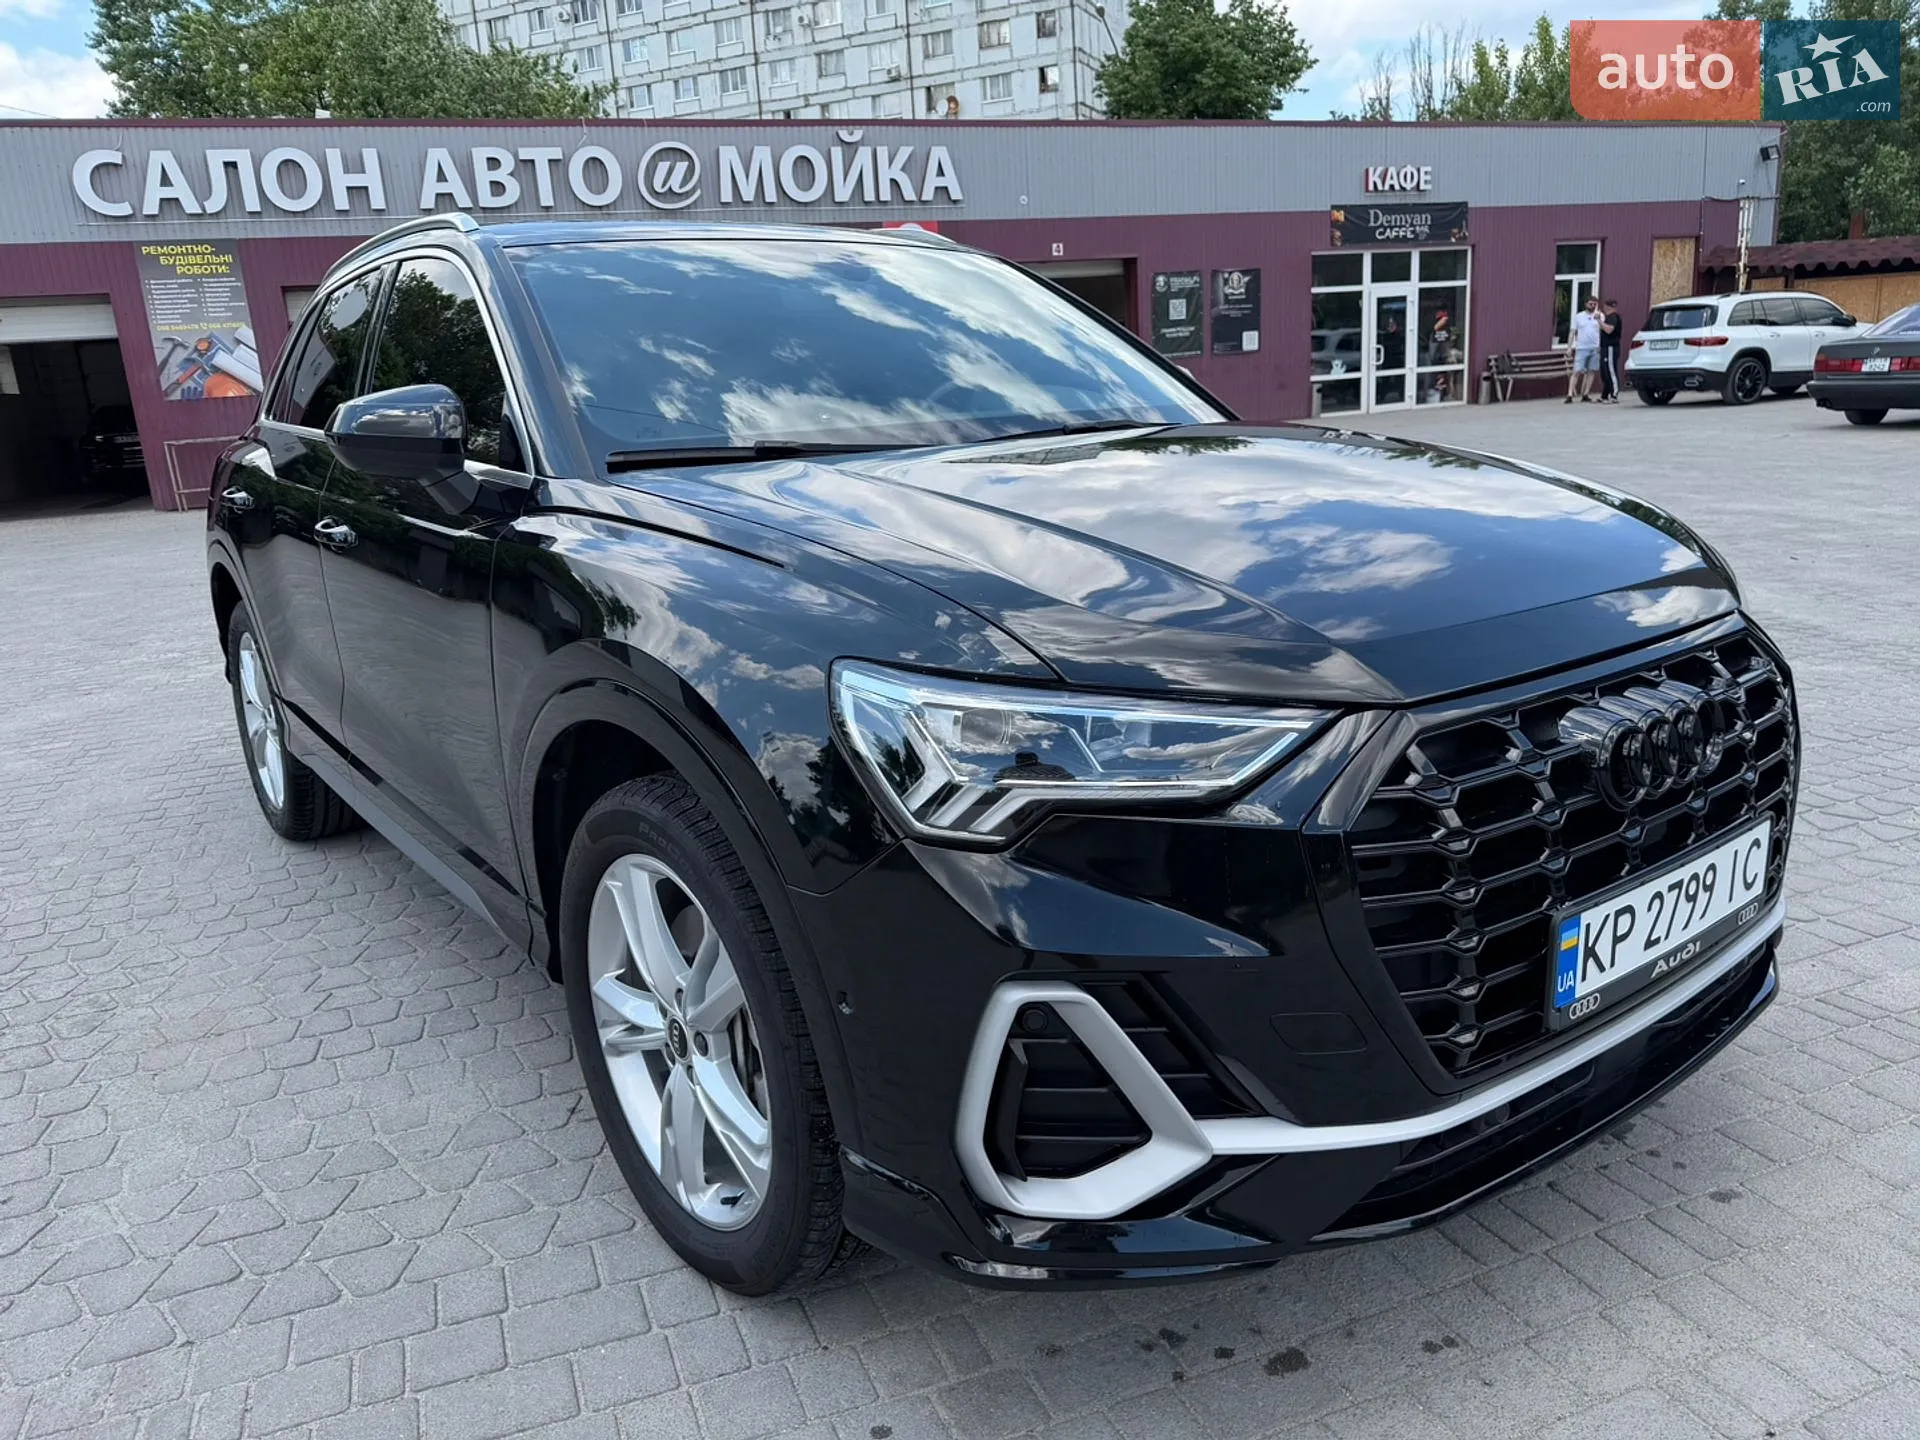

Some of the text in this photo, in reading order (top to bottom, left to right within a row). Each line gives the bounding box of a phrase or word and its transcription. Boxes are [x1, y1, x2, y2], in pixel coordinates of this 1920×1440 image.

[72, 147, 387, 217] САЛОН
[419, 144, 623, 210] АВТО
[718, 129, 964, 204] МОЙКА
[1365, 164, 1433, 193] КАФЕ
[1368, 208, 1432, 228] Demyan
[141, 244, 216, 255] РЕМОНТНО-
[159, 255, 233, 265] БУДІВЕЛЬНІ
[176, 265, 231, 274] РОБОТИ:
[1580, 904, 1636, 983] KP
[1643, 862, 1717, 952] 2799
[1557, 970, 1575, 992] UA
